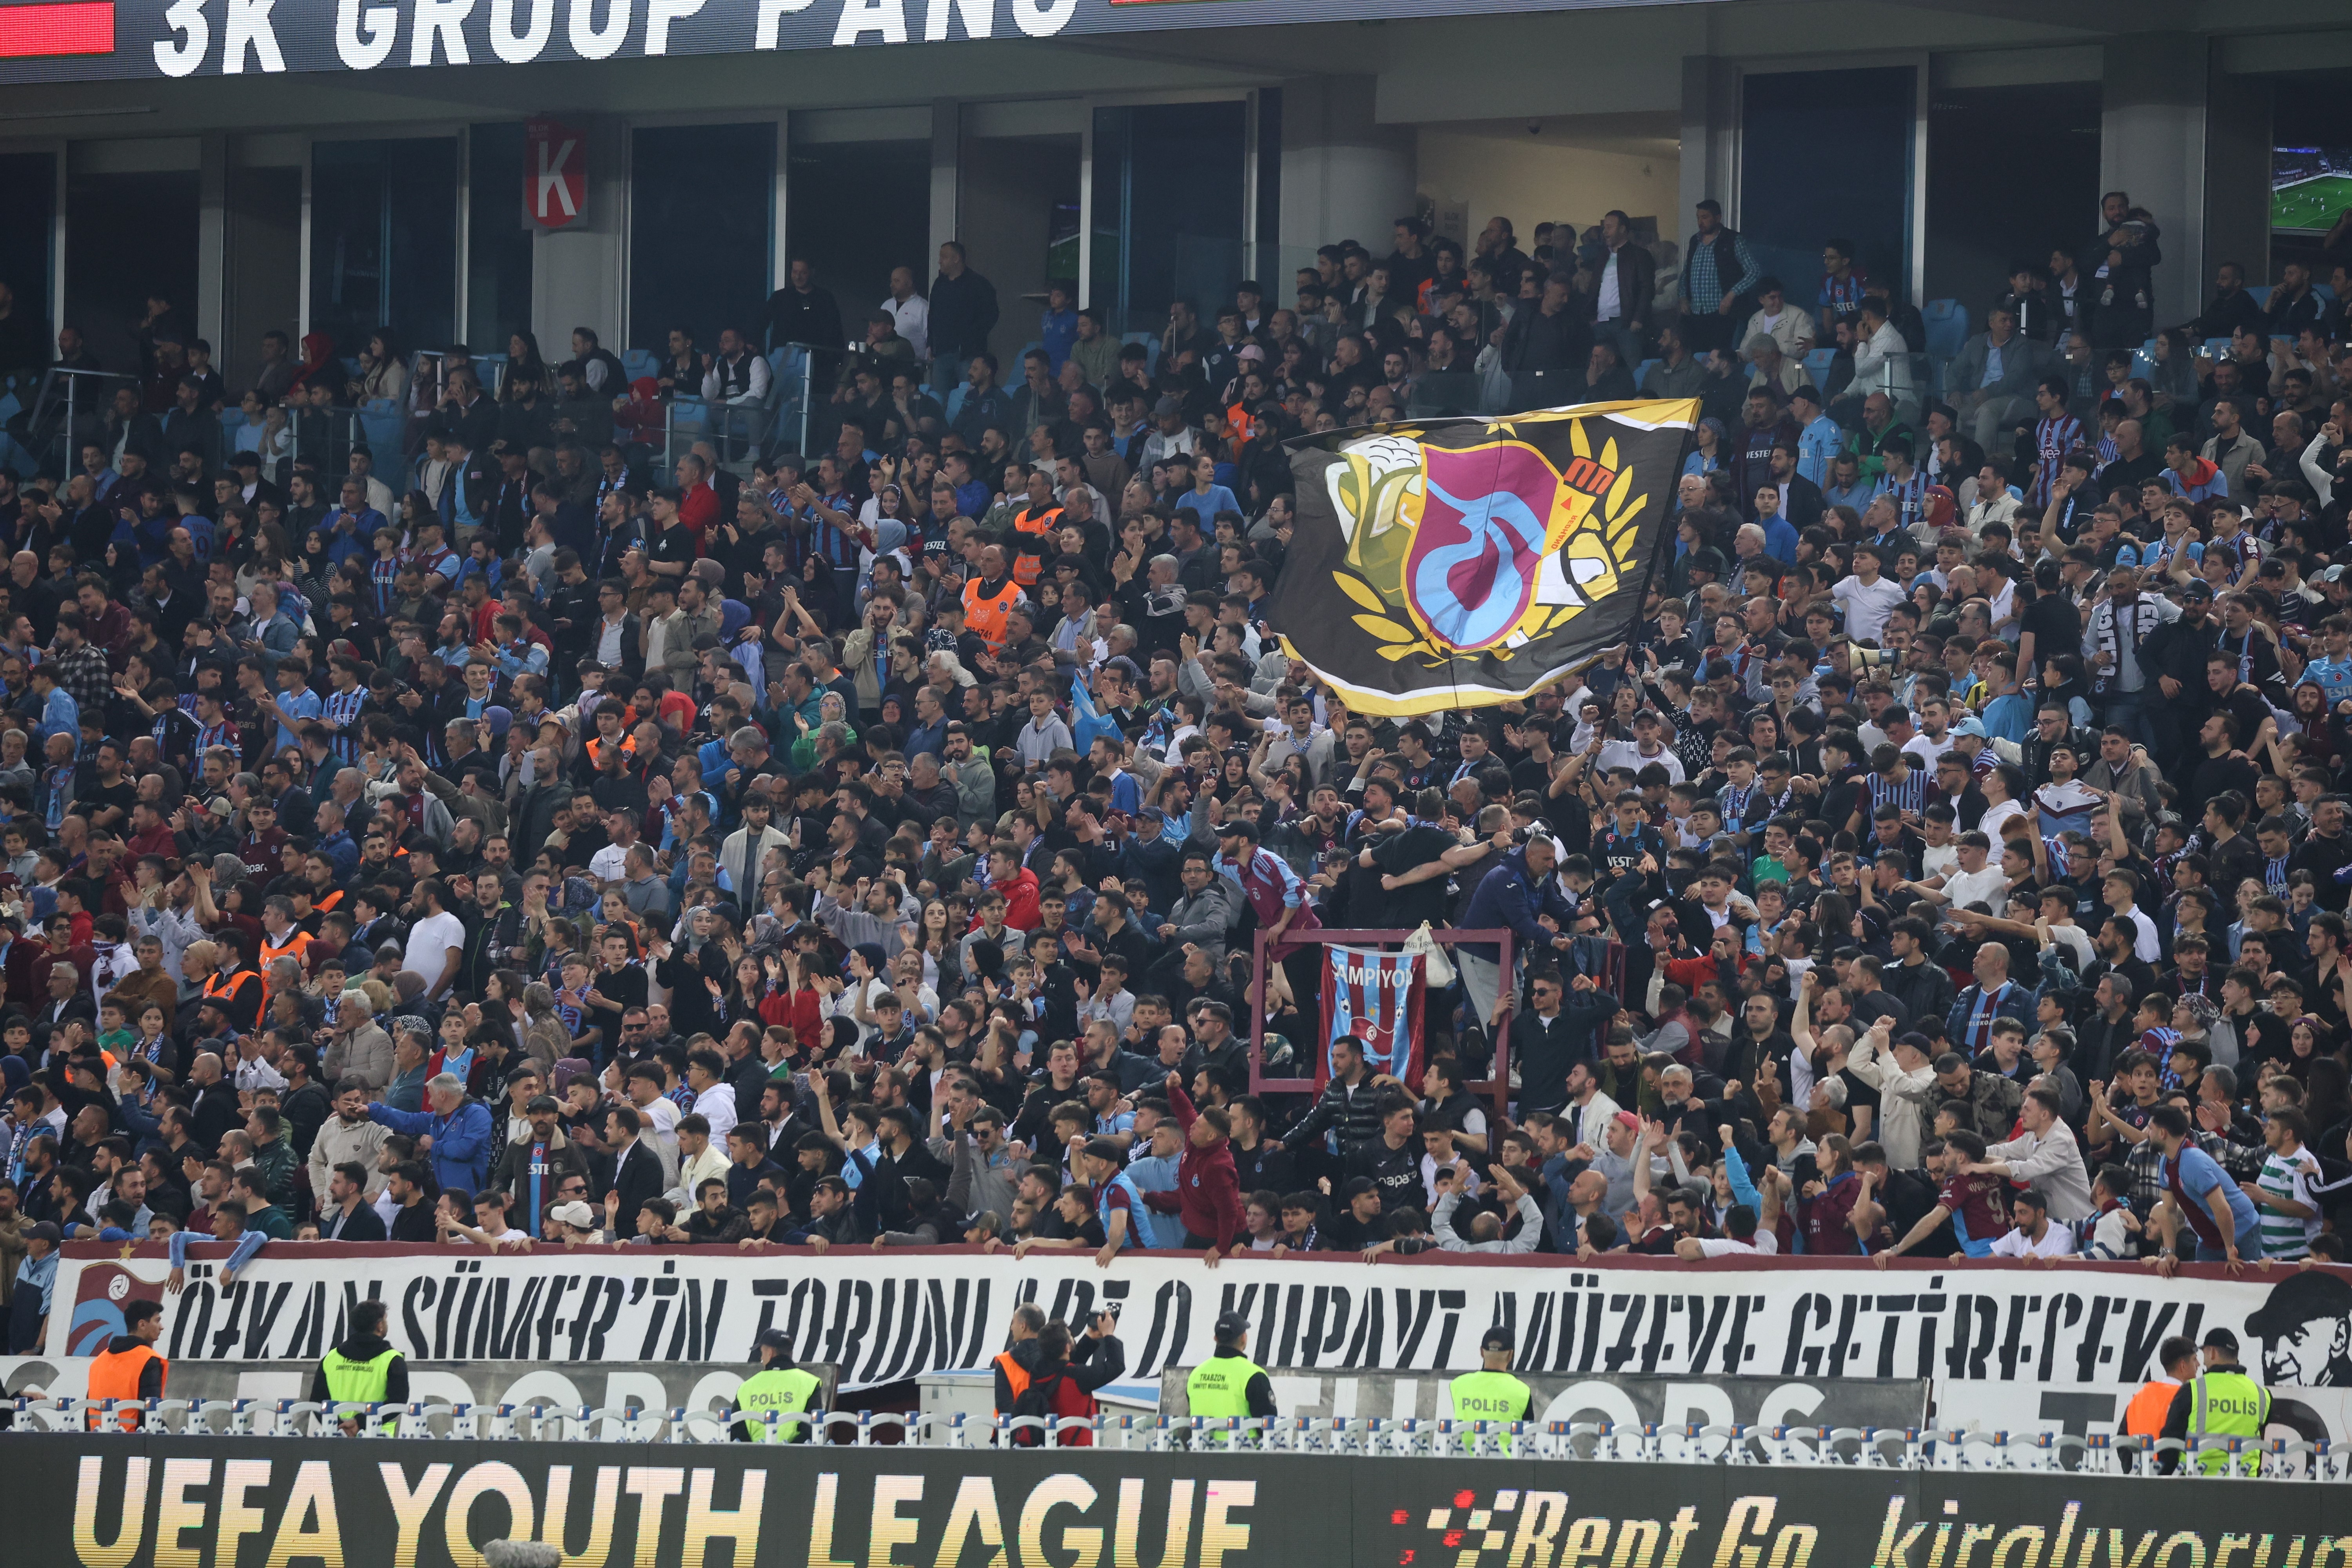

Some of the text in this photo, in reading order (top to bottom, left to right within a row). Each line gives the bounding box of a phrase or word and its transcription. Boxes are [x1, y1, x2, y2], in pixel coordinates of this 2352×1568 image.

[153, 0, 287, 77] 3K
[537, 139, 577, 218] K
[196, 535, 209, 559] 9
[1986, 1187, 2005, 1225] 9
[1483, 1273, 1766, 1374] MÜZEYE
[73, 1455, 1256, 1568] UEFA YOUTH LEAGUE
[1506, 1490, 1699, 1568] Rent
[1712, 1495, 1818, 1568] Go
